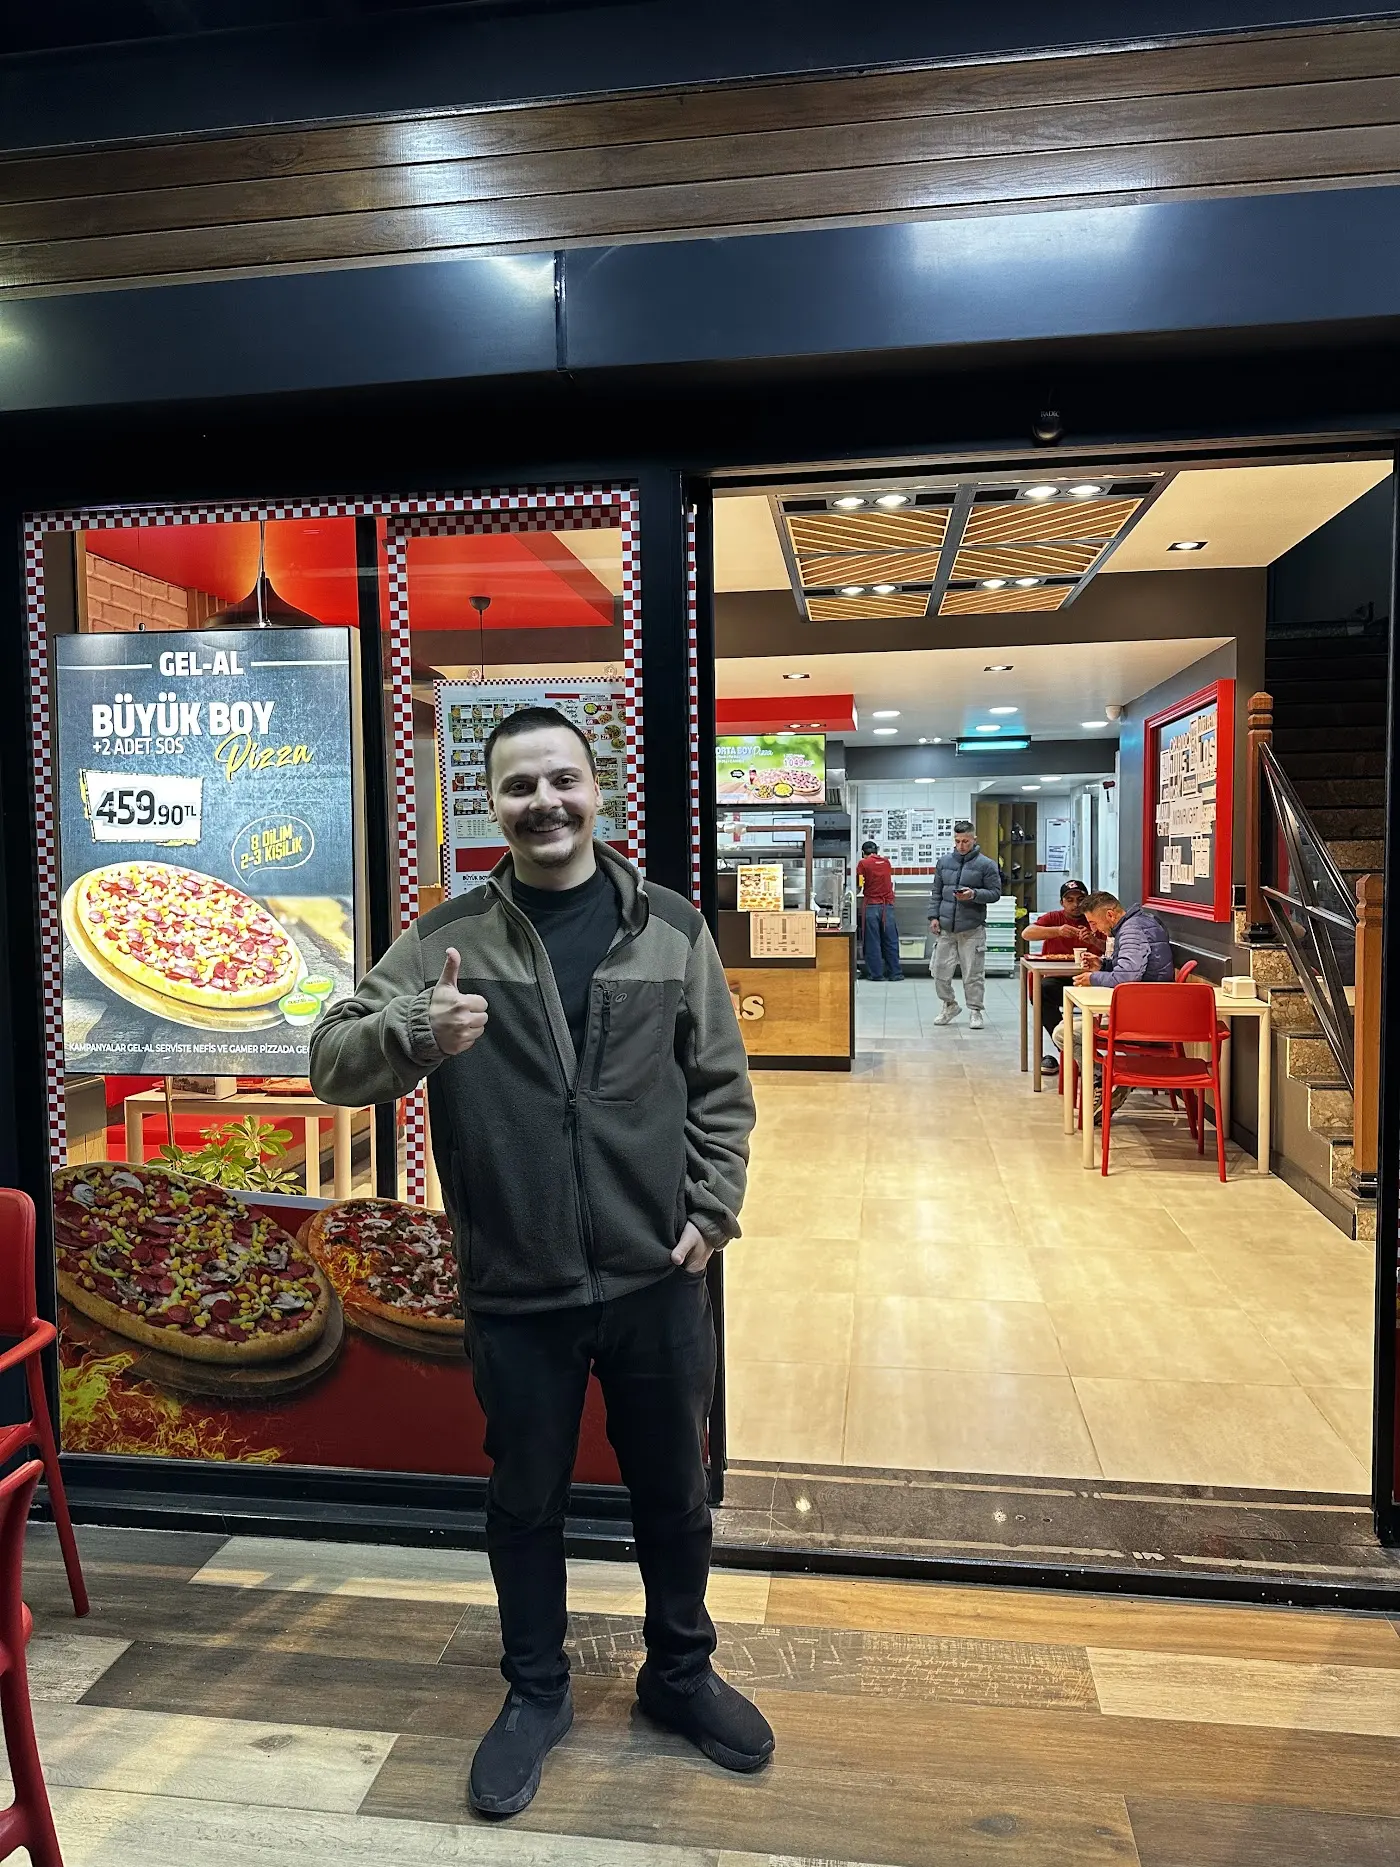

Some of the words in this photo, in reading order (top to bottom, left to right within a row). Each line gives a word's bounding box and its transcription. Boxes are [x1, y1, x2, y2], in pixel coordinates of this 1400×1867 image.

[159, 651, 244, 676] GEL-AL
[92, 692, 202, 737] BÜYÜK
[209, 701, 275, 736] BOY
[93, 739, 112, 755] +2
[113, 738, 152, 755] ADET
[155, 737, 184, 754] SOS
[214, 732, 313, 783] Pizza
[251, 834, 258, 851] 8
[240, 849, 262, 870] 2-3
[69, 1043, 126, 1053] KAMPANYALAR
[127, 1044, 154, 1053] GEL-AL
[155, 1042, 192, 1053] SERVİSTE
[193, 1042, 216, 1053] NEFİS
[217, 1045, 228, 1053] VE
[229, 1045, 258, 1054] GAMER
[260, 1043, 295, 1054] PİZZADA
